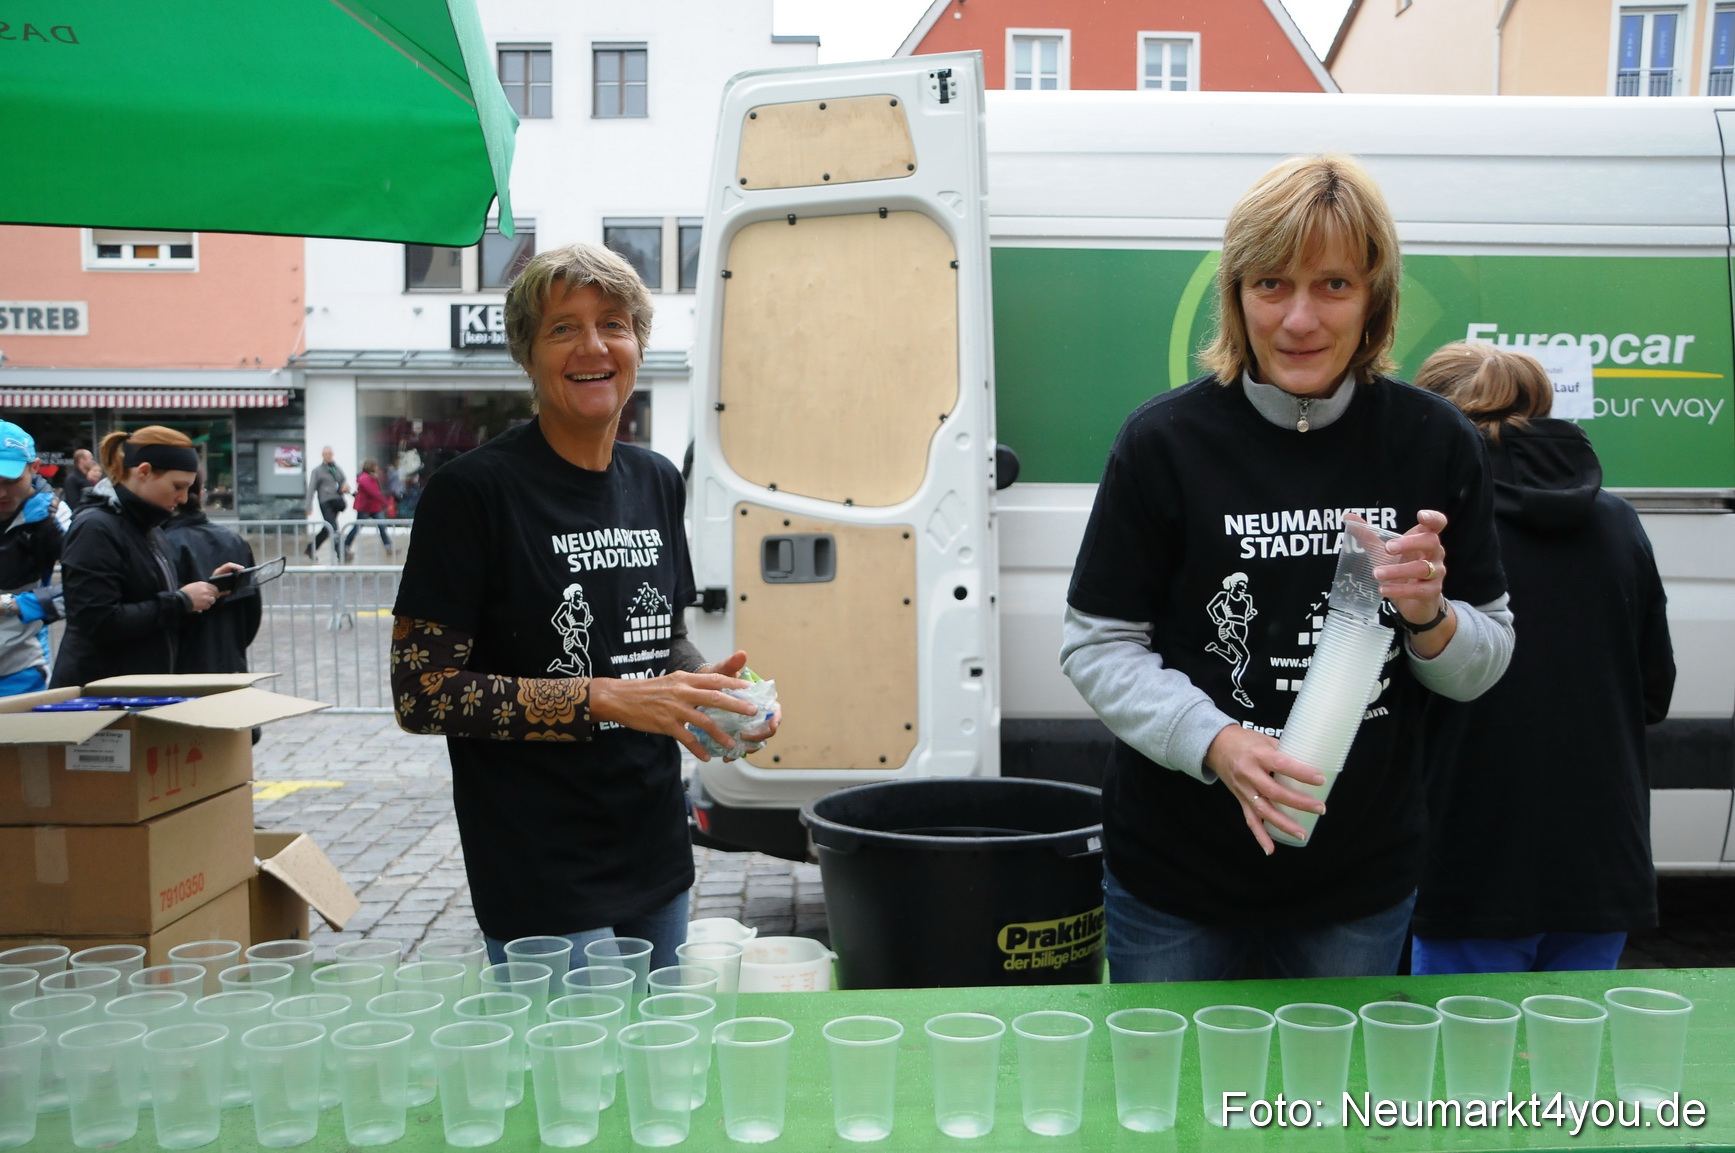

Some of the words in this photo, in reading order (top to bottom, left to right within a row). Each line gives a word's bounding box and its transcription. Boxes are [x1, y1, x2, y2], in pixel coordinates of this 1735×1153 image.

[1554, 382, 1580, 393] Lauf
[1592, 397, 1645, 418] our
[1650, 397, 1725, 425] way
[1223, 507, 1397, 536] NEUMARKTER
[551, 528, 664, 554] NEUMARKTER
[567, 547, 660, 573] STADTLAUF
[159, 872, 205, 912] 7910350
[1006, 911, 1105, 950] Praktike
[1003, 953, 1030, 970] der
[1031, 950, 1070, 970] billige
